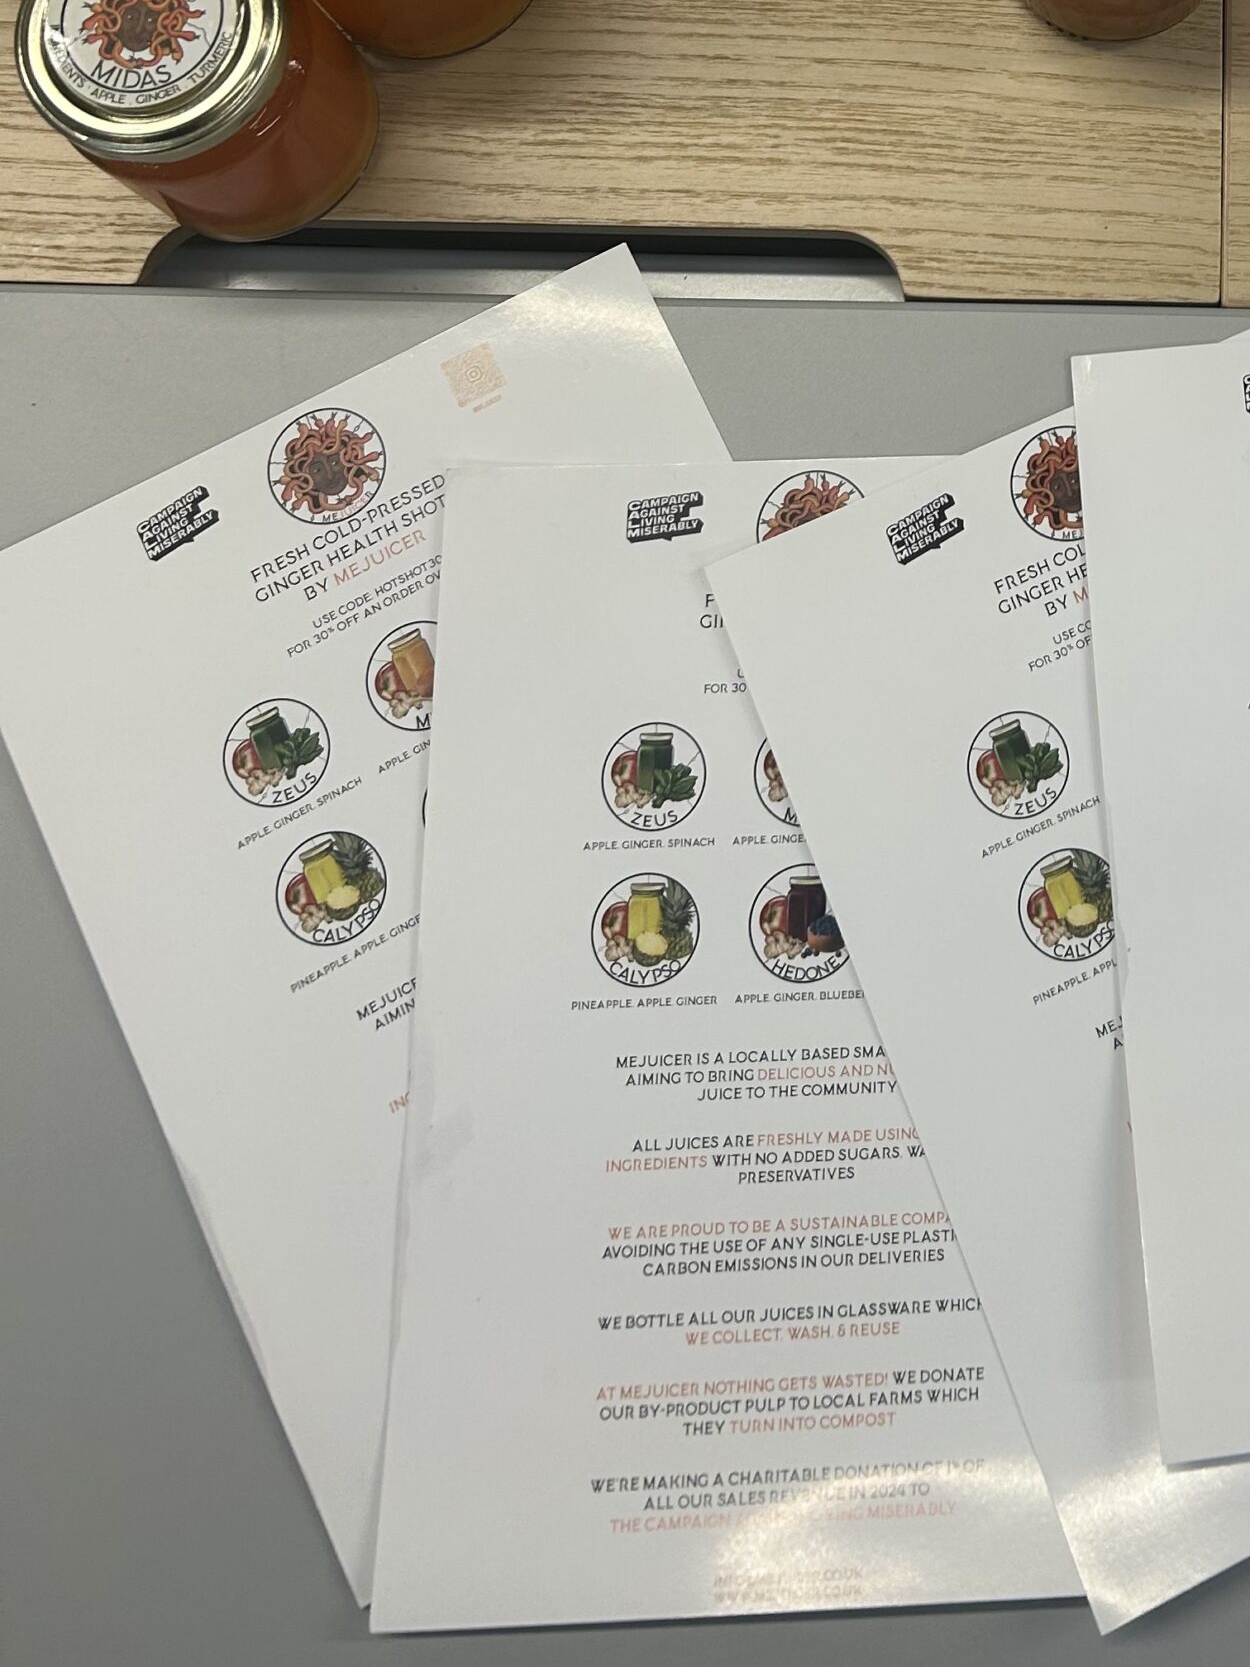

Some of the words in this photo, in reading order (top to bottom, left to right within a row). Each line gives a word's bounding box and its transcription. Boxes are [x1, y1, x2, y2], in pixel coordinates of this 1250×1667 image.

[90, 88, 126, 105] APPLE
[135, 84, 182, 105] GINGER
[188, 30, 235, 87] TURMERIC
[91, 59, 172, 92] MIDAS
[250, 543, 310, 583] FRESH
[312, 474, 444, 550] COLD-PRESSED
[302, 575, 328, 601] BY
[332, 529, 426, 586] MEJUICER
[993, 563, 1048, 596] FRESH
[997, 575, 1064, 614] GINGER
[272, 772, 318, 804] ZEUS
[1013, 787, 1058, 816] ZEUS
[629, 809, 679, 829] ZEUS
[312, 898, 382, 946] CALYPSO
[697, 1086, 742, 1101] JUICE
[745, 1085, 765, 1099] TO
[768, 1084, 798, 1098] THE
[801, 1079, 897, 1096] COMMUNITY
[642, 1260, 711, 1276] CARBON
[714, 1255, 797, 1273] EMISSIONS
[801, 1254, 816, 1268] IN
[820, 1252, 853, 1267] OUR
[858, 1248, 944, 1265] DELIVERIES
